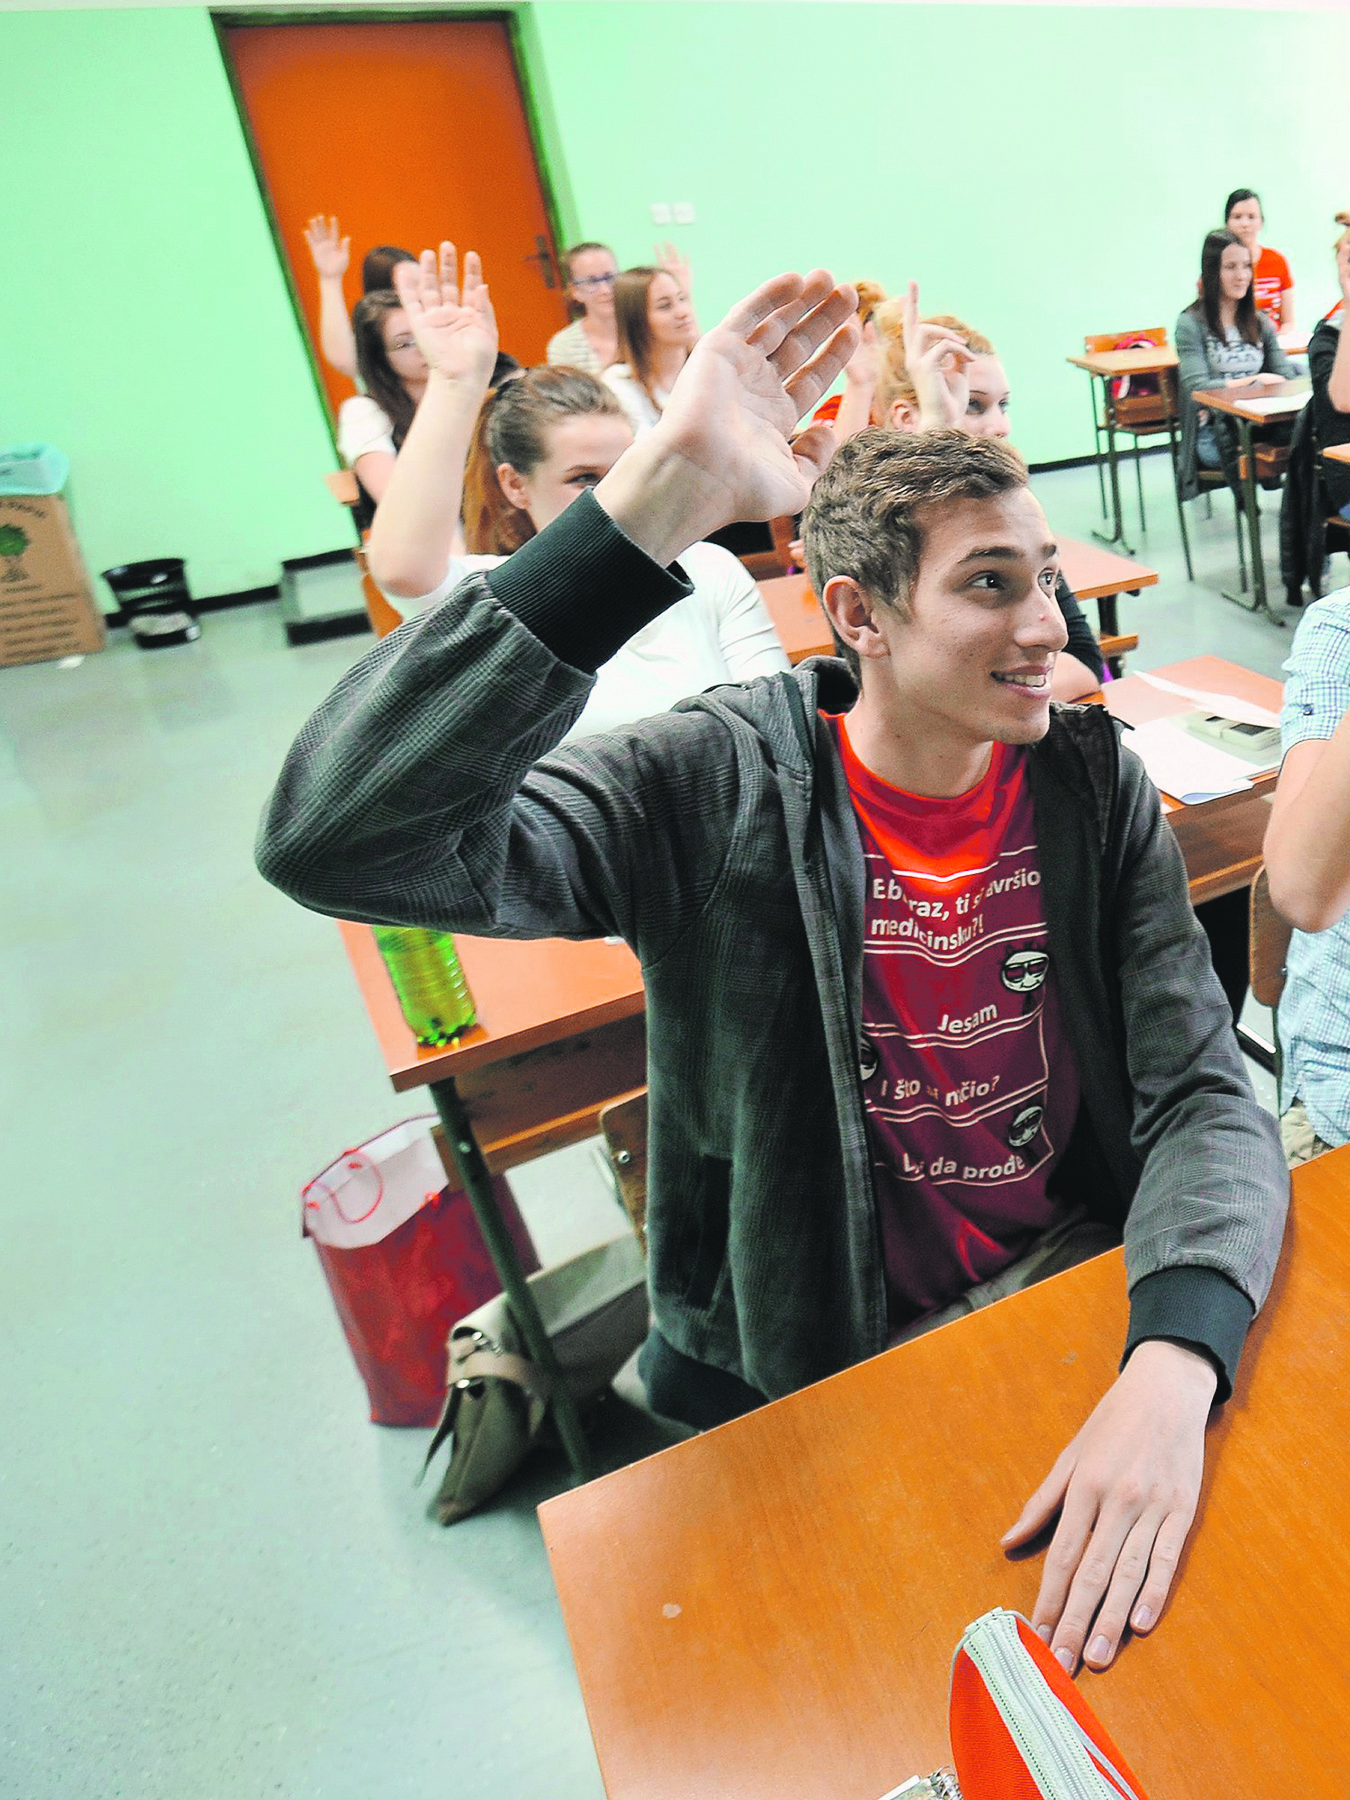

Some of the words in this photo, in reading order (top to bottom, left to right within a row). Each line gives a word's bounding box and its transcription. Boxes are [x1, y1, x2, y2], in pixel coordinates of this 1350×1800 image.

[955, 893, 971, 915] ti
[937, 1003, 998, 1035] Jesam
[930, 1156, 957, 1176] da
